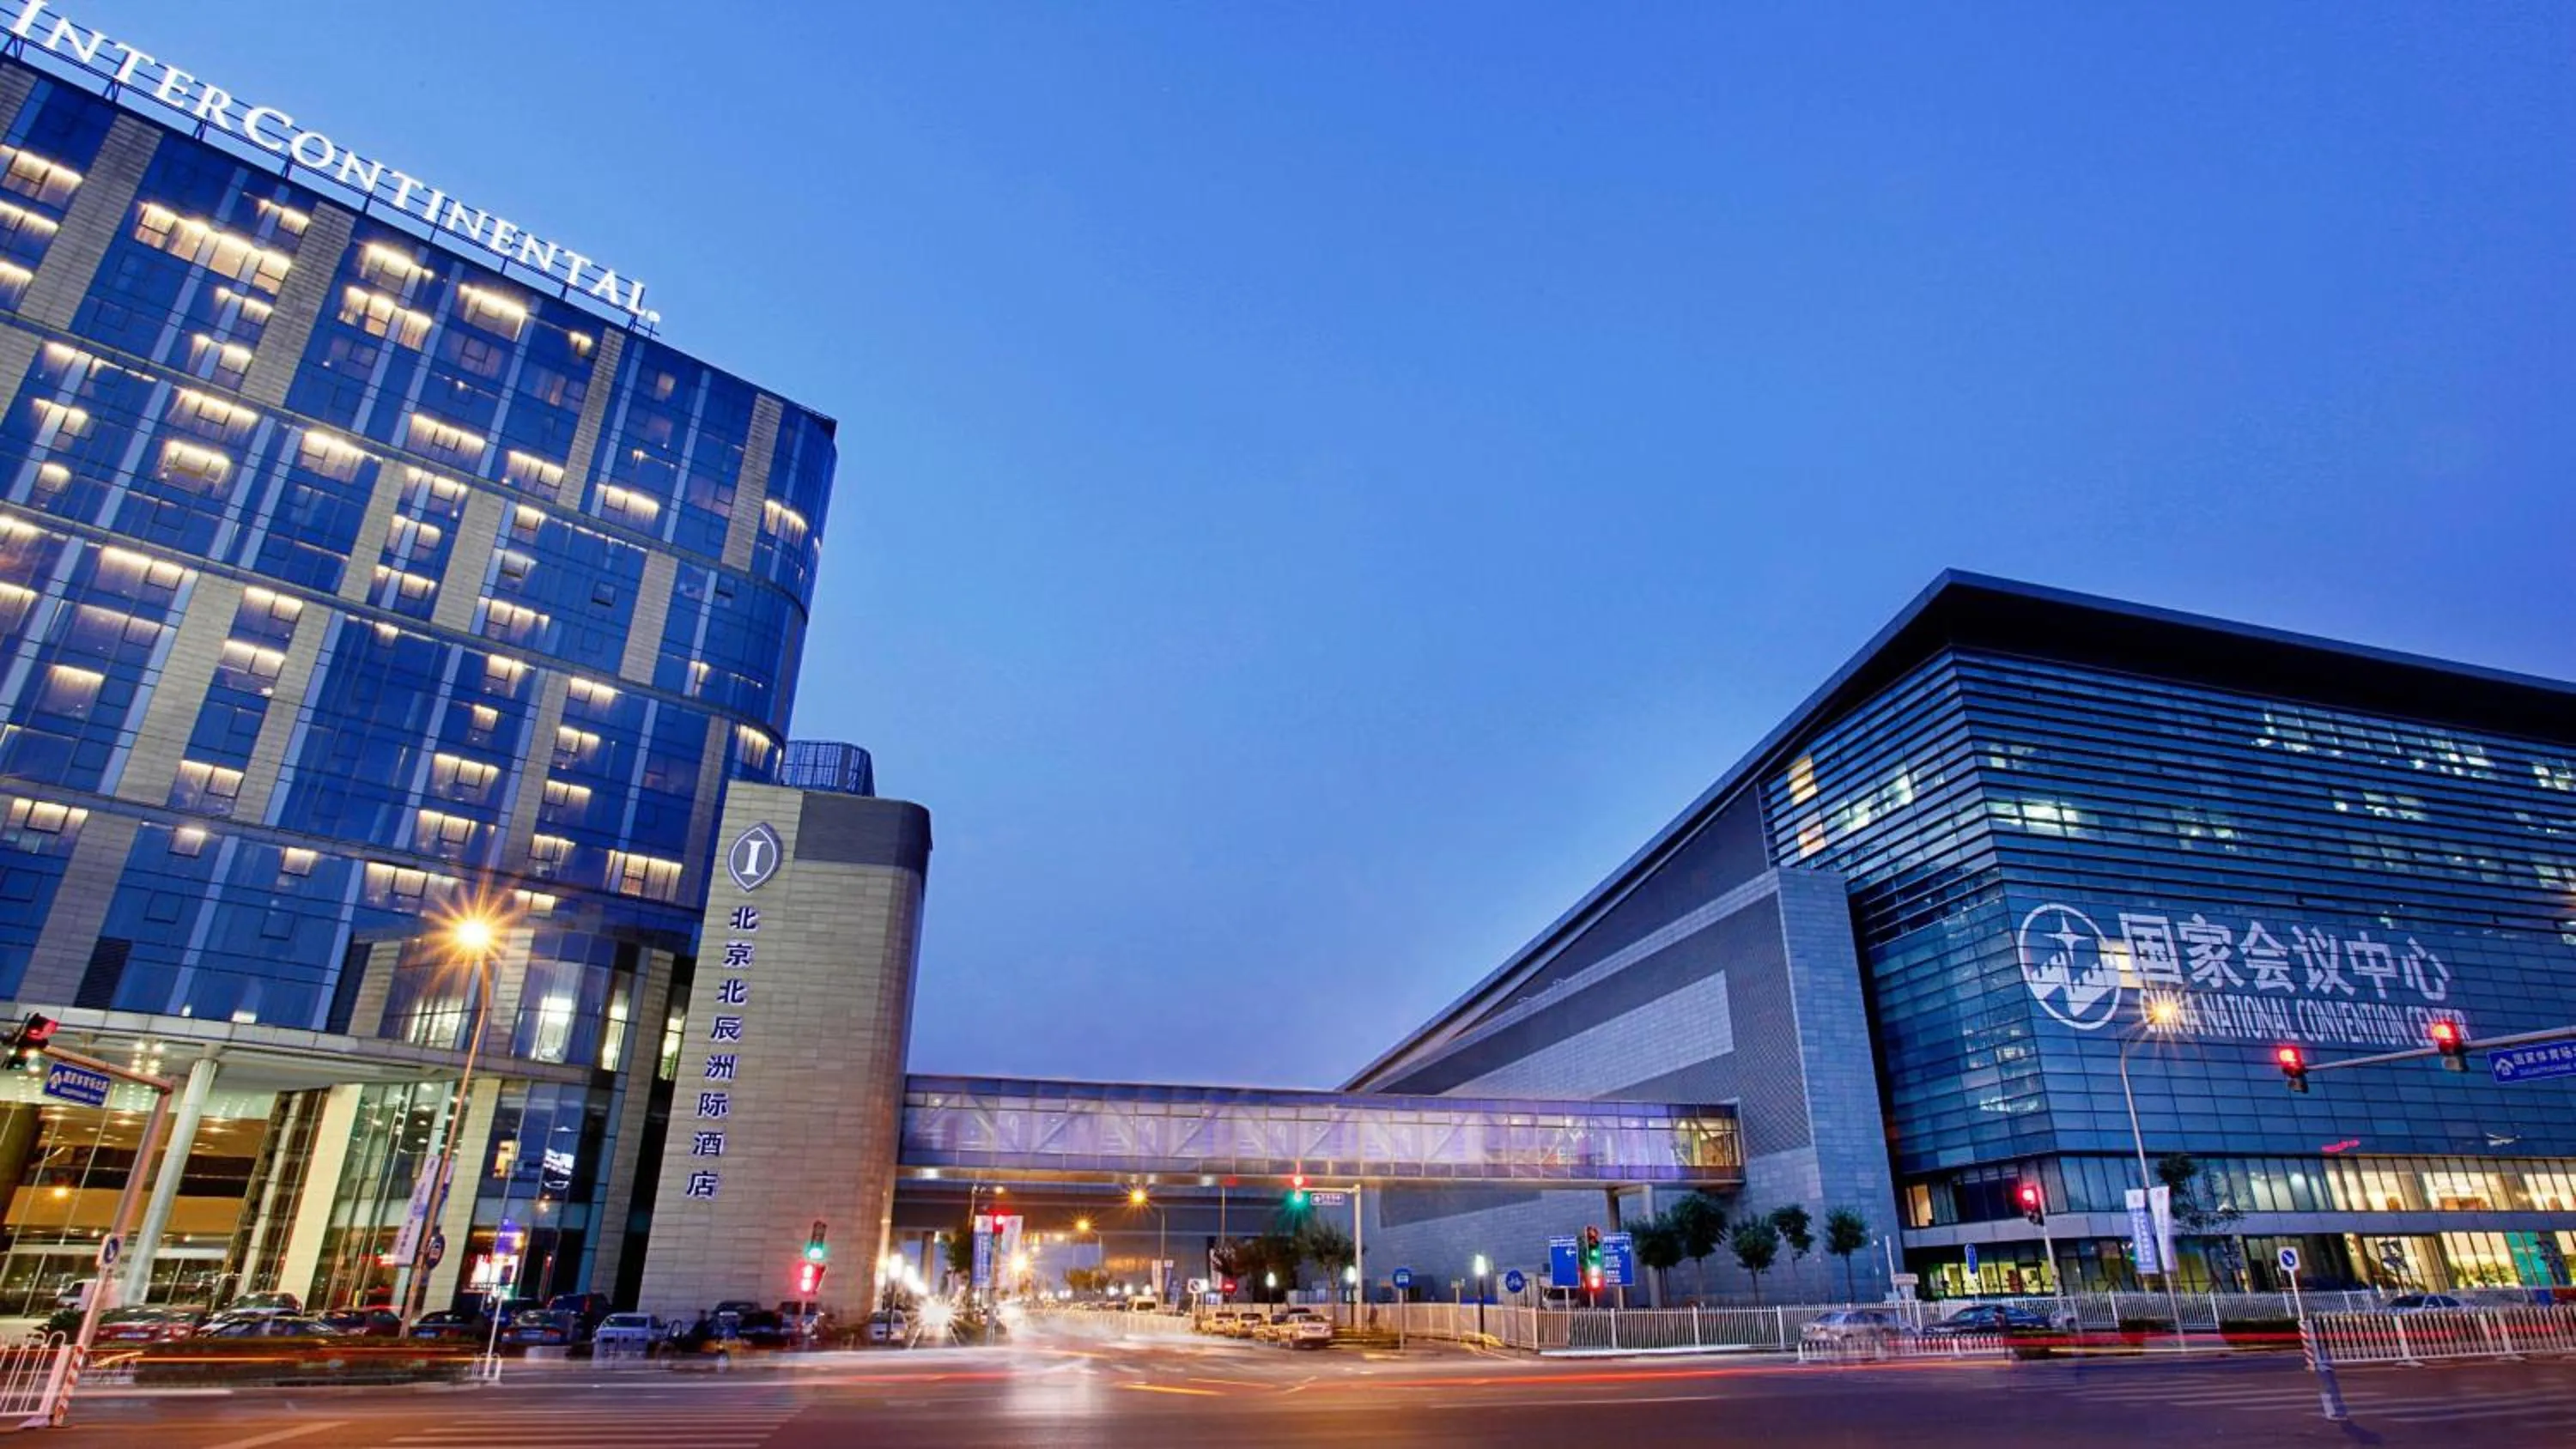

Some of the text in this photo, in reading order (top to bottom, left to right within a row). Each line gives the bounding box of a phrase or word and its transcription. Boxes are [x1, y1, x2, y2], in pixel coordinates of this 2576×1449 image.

[7, 0, 647, 318] INTERCONTINENTAL
[686, 906, 760, 1198] 北京北辰洲际酒店
[2118, 912, 2452, 1002] 国家会议中心
[2200, 992, 2298, 1040] NATIONAL
[2296, 999, 2410, 1046] CONVENTION
